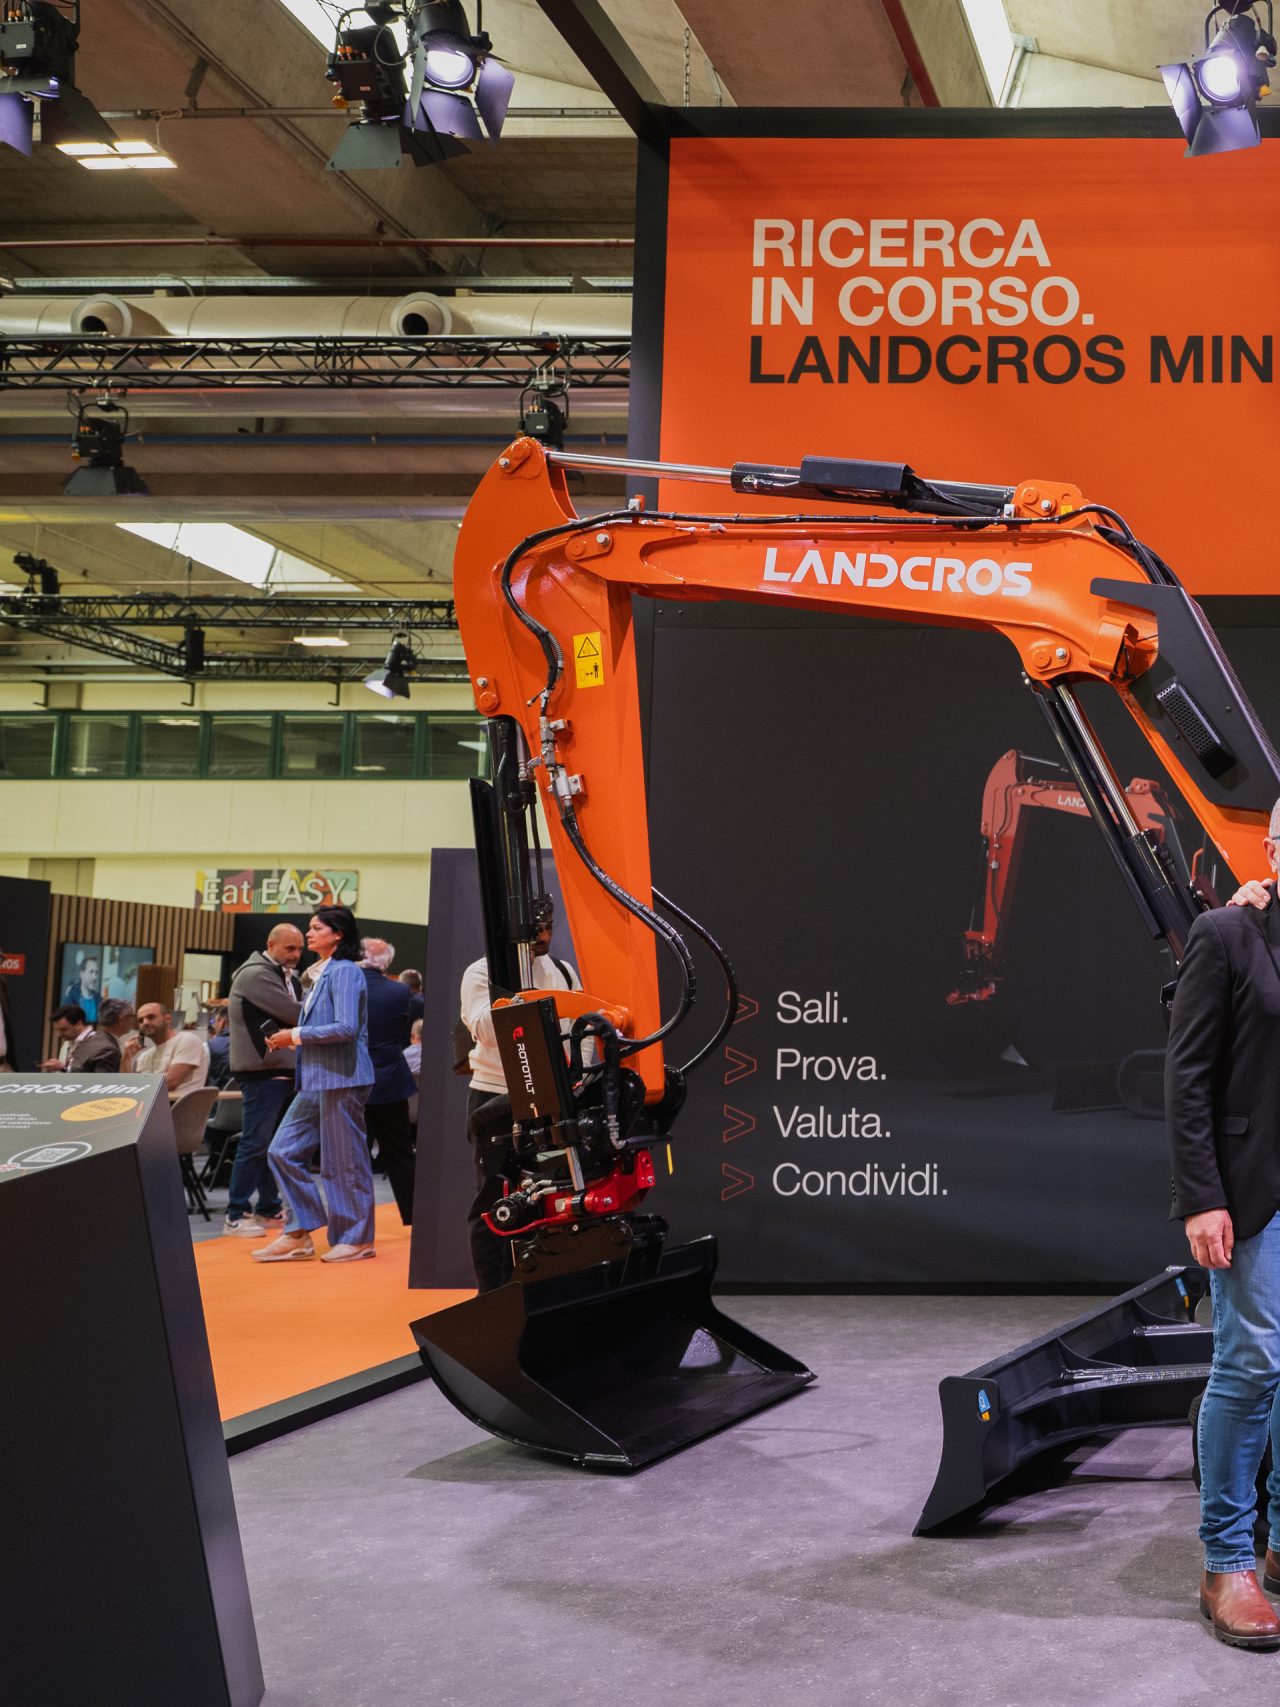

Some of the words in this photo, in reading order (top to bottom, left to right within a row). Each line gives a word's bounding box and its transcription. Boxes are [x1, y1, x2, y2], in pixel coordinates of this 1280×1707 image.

[752, 219, 1052, 267] RICERCA
[751, 277, 814, 325] IN
[837, 276, 1095, 326] CORSO.
[749, 334, 1126, 384] LANDCROS
[763, 547, 1033, 597] LANDCROS
[203, 878, 251, 905] Eat
[261, 877, 347, 906] EASY
[776, 990, 849, 1024] Sali.
[516, 1043, 535, 1095] ROTOTILT
[776, 1048, 887, 1081] Prova.
[81, 1084, 150, 1094] Mini
[773, 1105, 891, 1138] Valuta.
[772, 1162, 948, 1196] Condividi.
